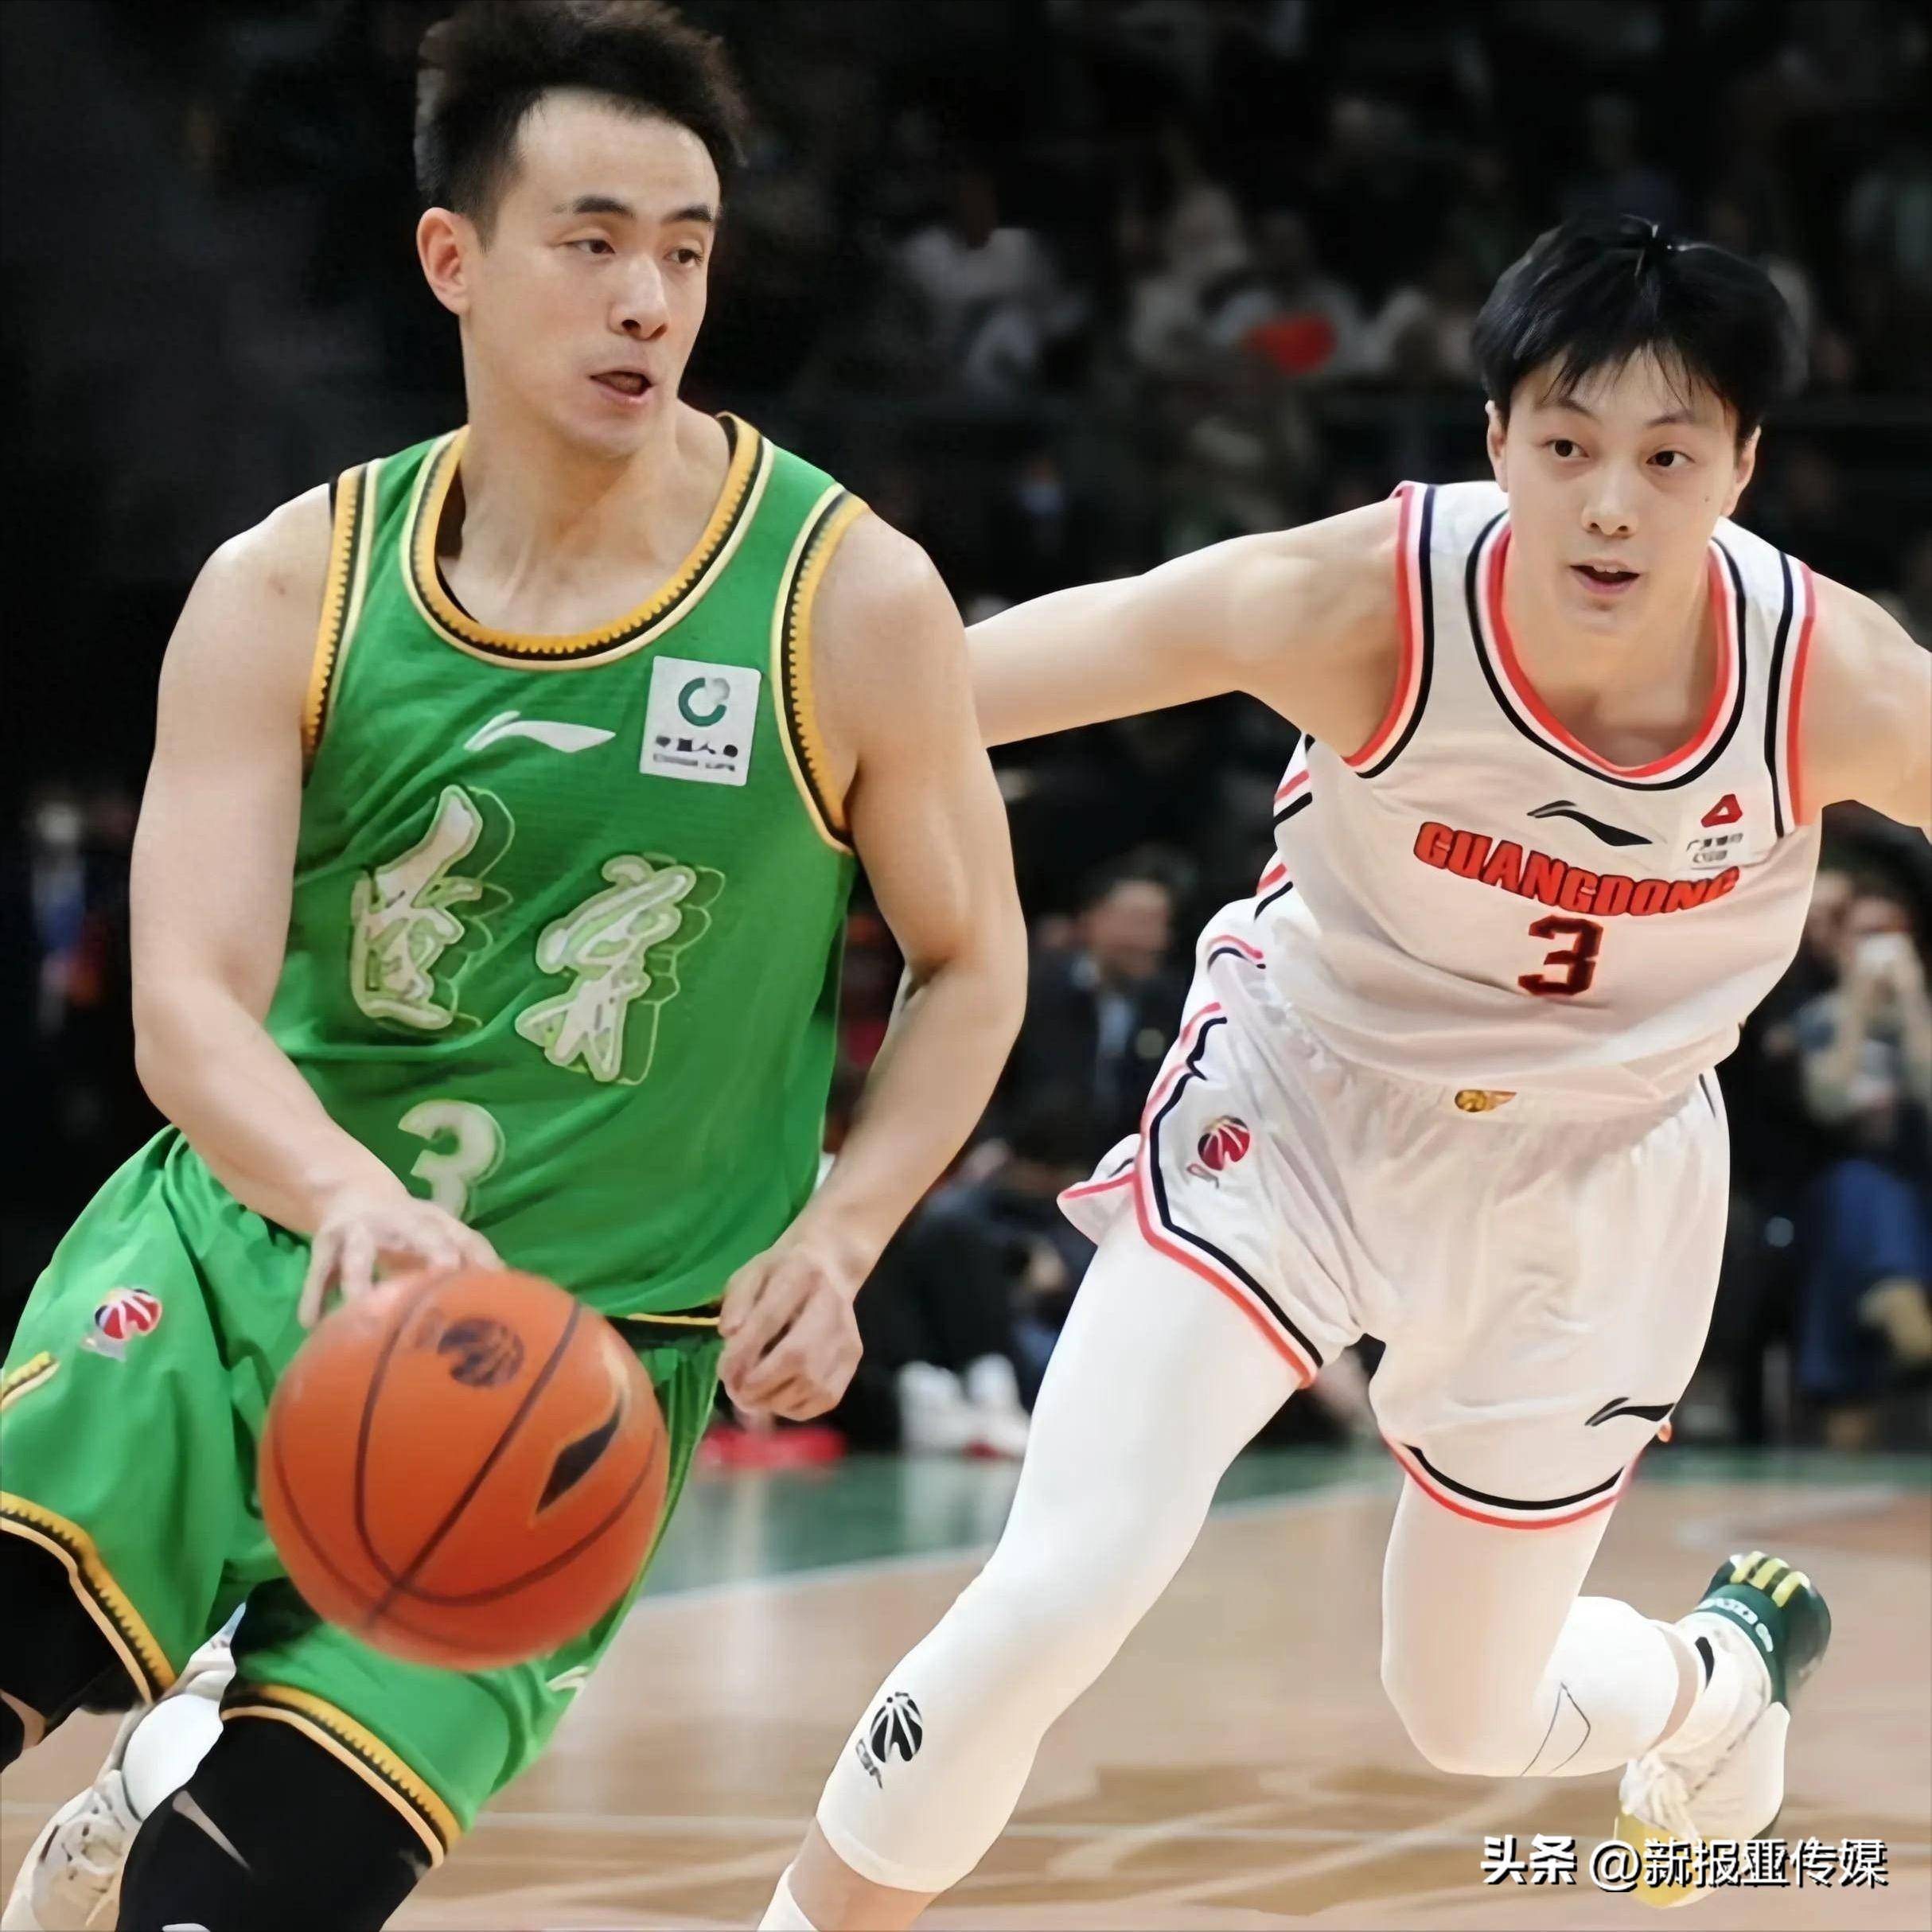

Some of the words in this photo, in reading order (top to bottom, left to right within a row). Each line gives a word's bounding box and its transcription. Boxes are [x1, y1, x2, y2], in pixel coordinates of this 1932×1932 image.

[1413, 821, 1740, 917] GUANGDONG
[1517, 914, 1604, 997] 3
[398, 1100, 506, 1224] 3
